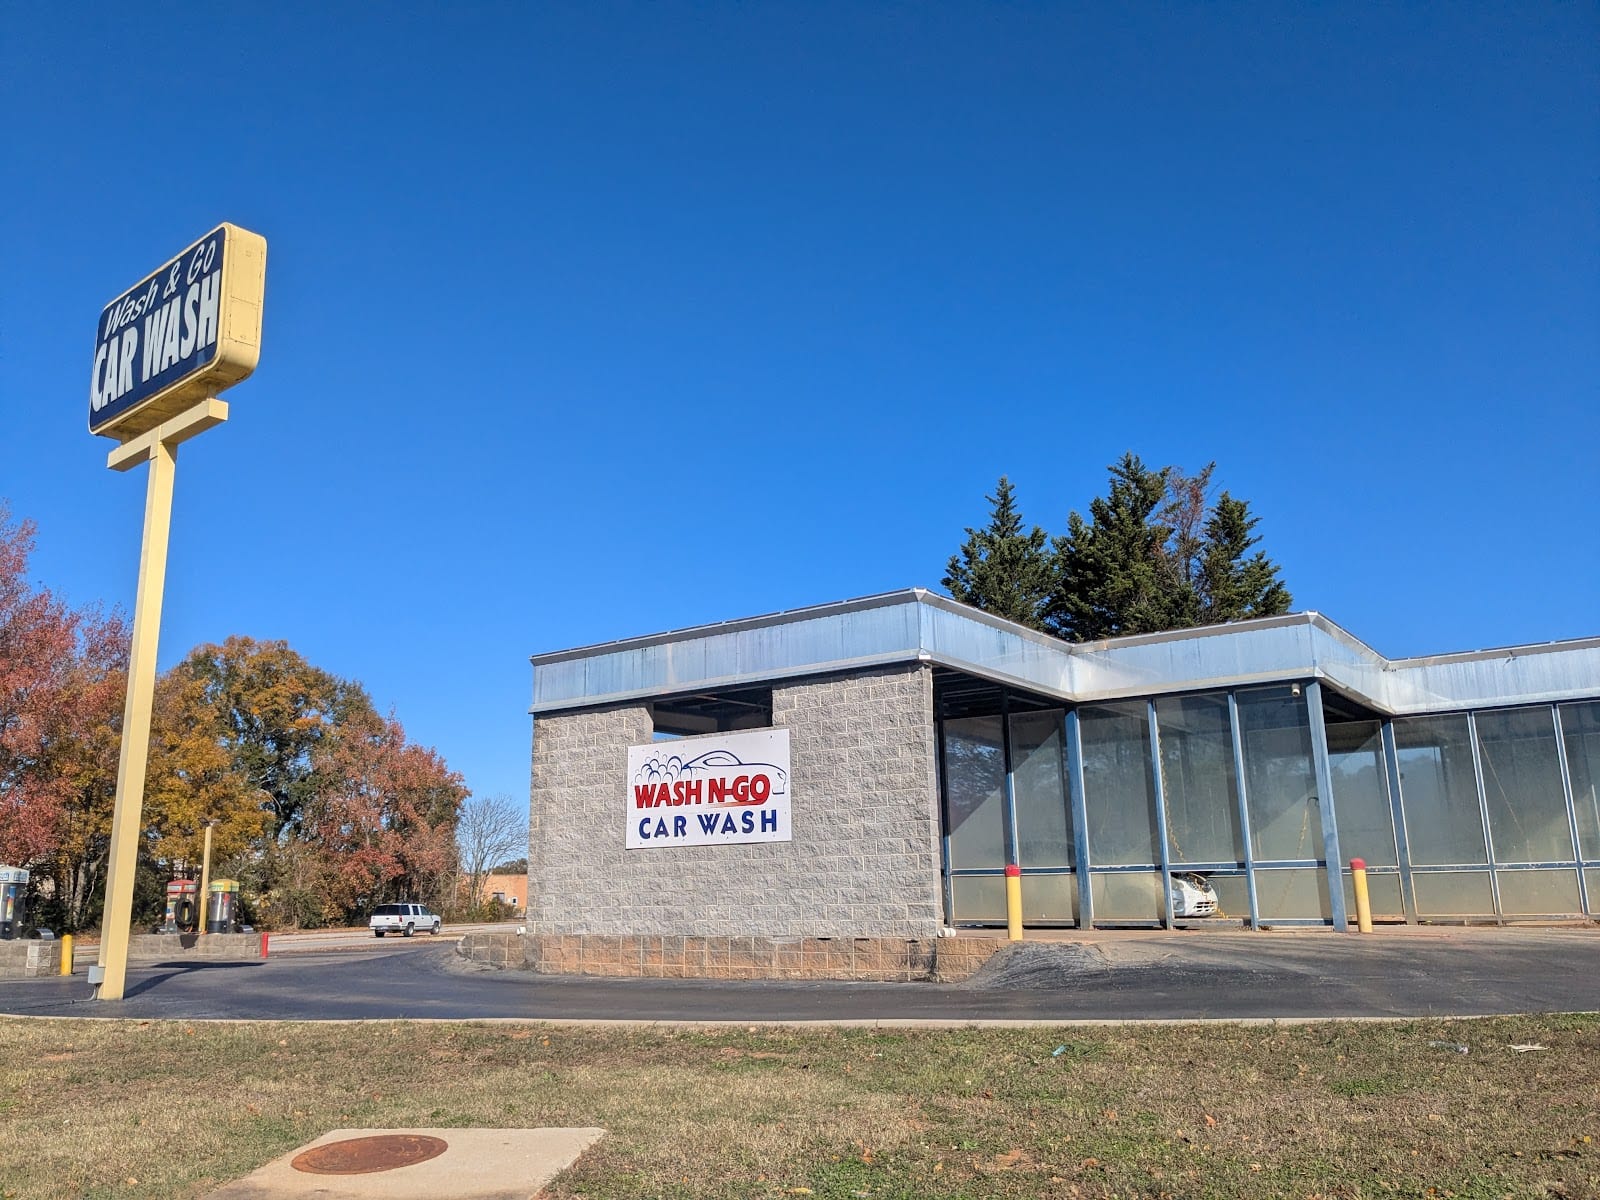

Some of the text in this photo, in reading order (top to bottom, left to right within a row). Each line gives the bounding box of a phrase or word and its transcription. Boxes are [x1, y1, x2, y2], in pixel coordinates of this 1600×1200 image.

[104, 279, 158, 340] Wash
[163, 261, 181, 299] &
[91, 269, 221, 412] CAR WASH
[634, 779, 702, 809] WASH
[638, 809, 777, 840] CAR WASH
